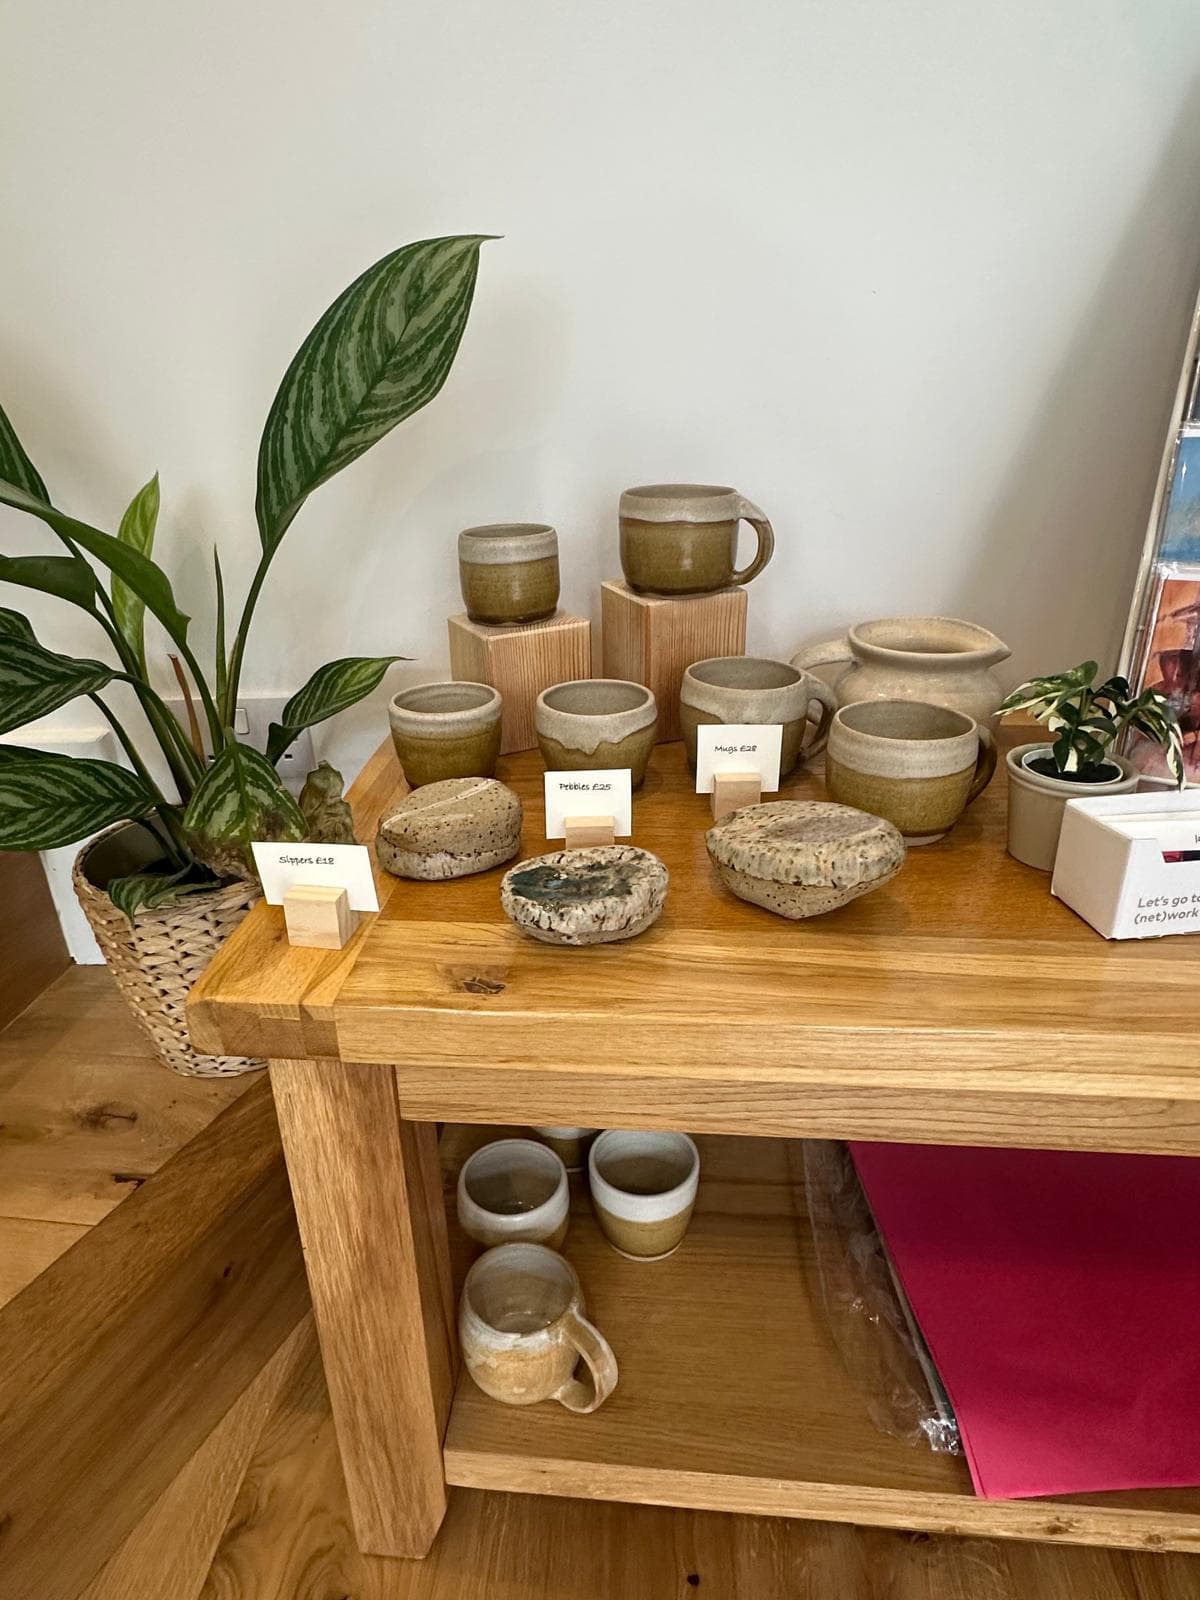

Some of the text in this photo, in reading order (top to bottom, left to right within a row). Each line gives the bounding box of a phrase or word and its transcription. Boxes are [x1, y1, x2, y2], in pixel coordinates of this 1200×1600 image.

[714, 745, 738, 754] Mugs
[559, 782, 611, 791] Pebbles £25
[279, 856, 314, 866] Sippers
[1171, 897, 1188, 907] go
[1134, 908, 1199, 925] (net)work
